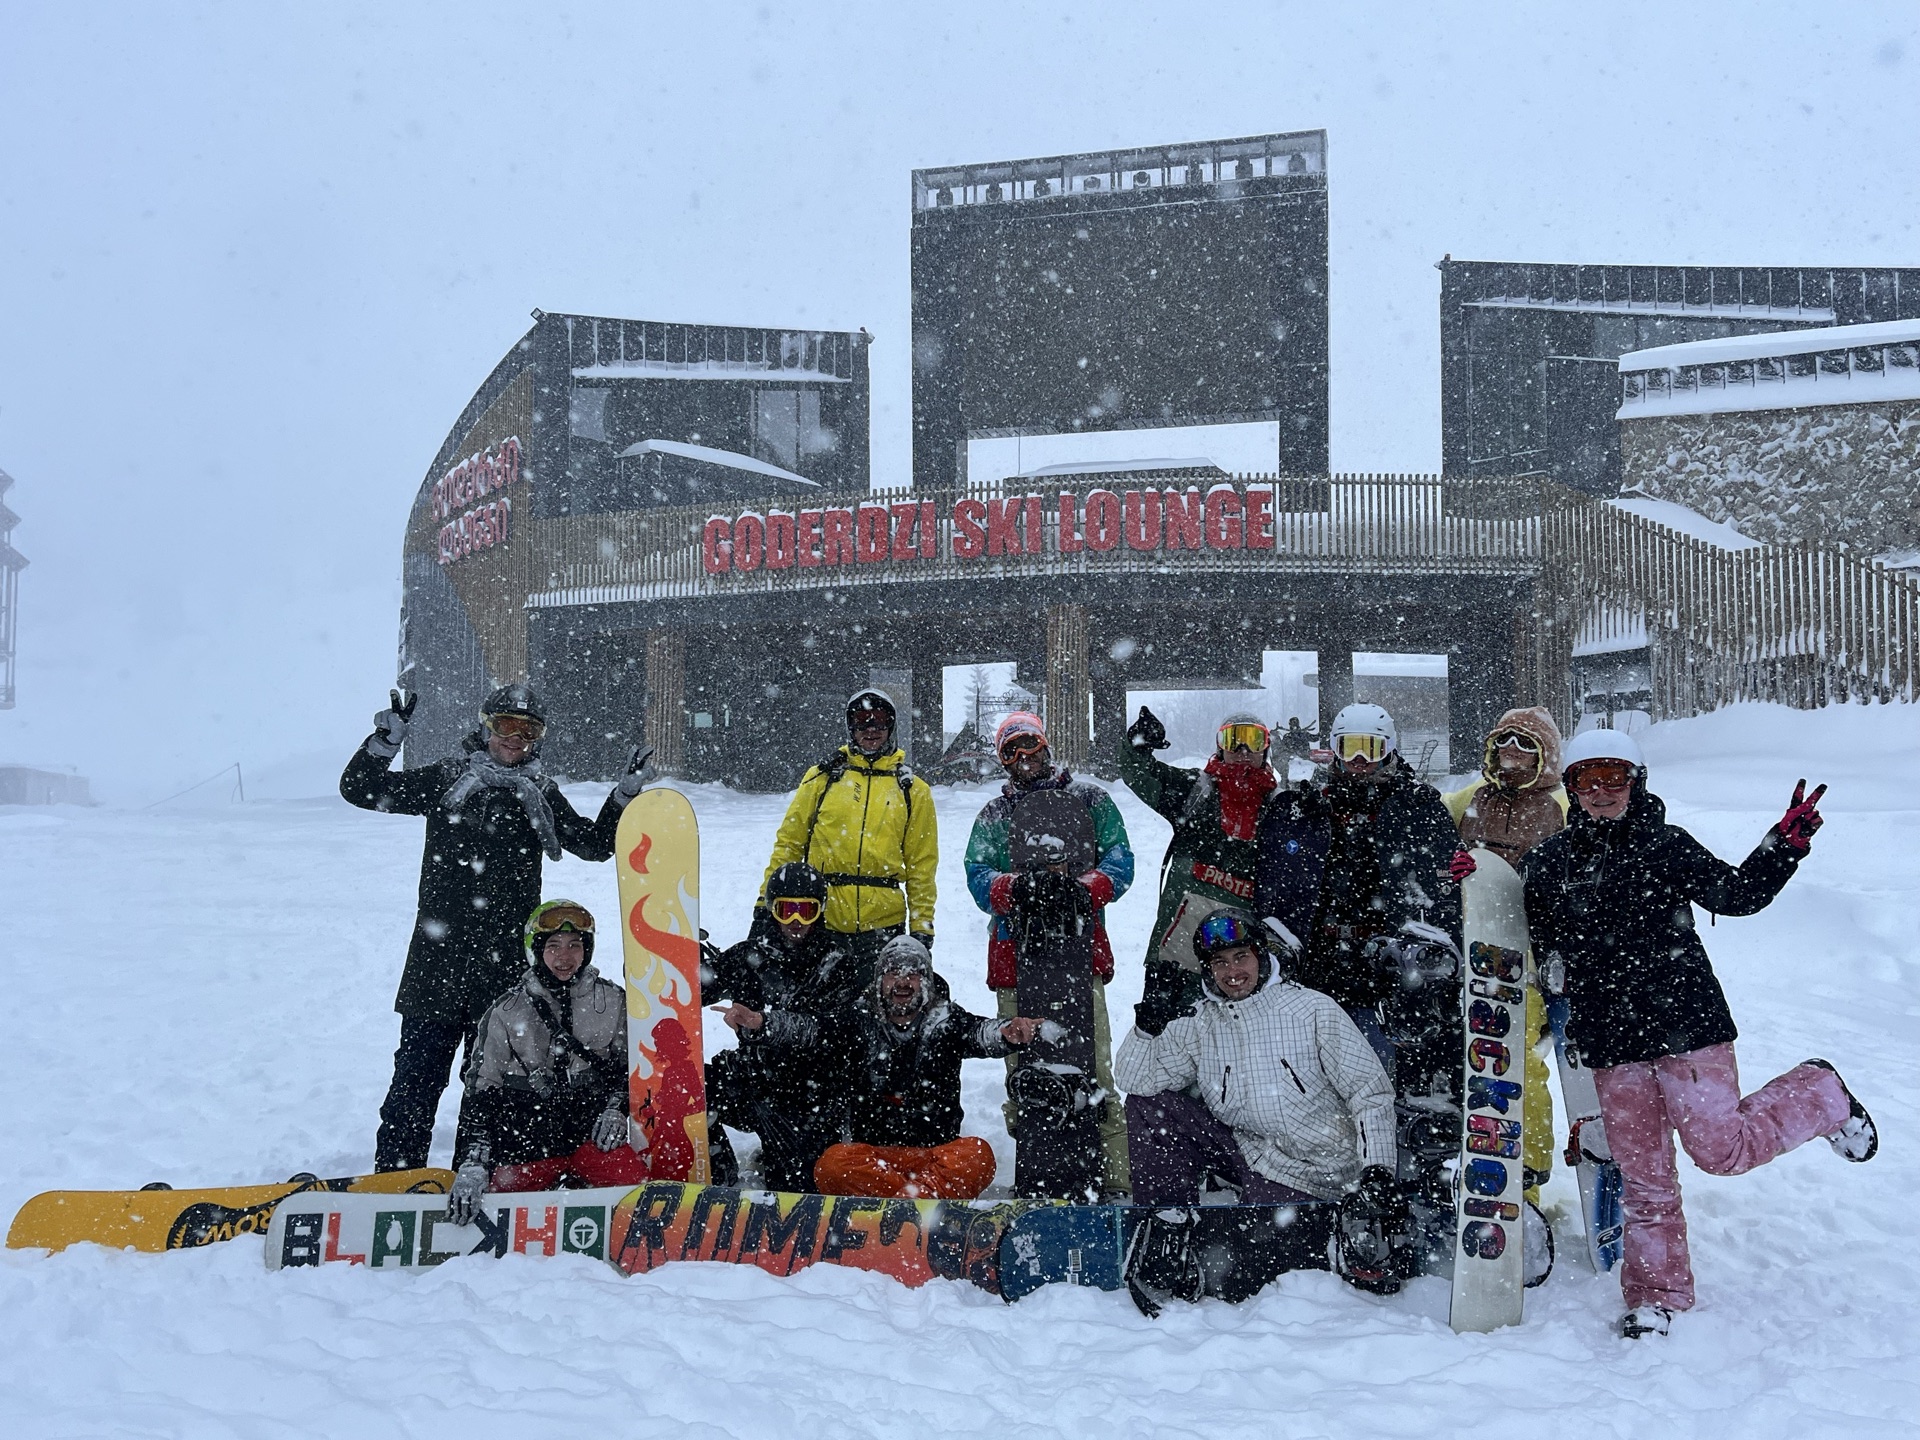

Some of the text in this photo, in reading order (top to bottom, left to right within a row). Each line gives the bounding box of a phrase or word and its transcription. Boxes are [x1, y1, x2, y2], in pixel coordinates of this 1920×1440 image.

[703, 487, 1275, 574] GODERDZI SKI LOUNGE
[1201, 867, 1254, 898] PROTE
[694, 1136, 704, 1185] COTT
